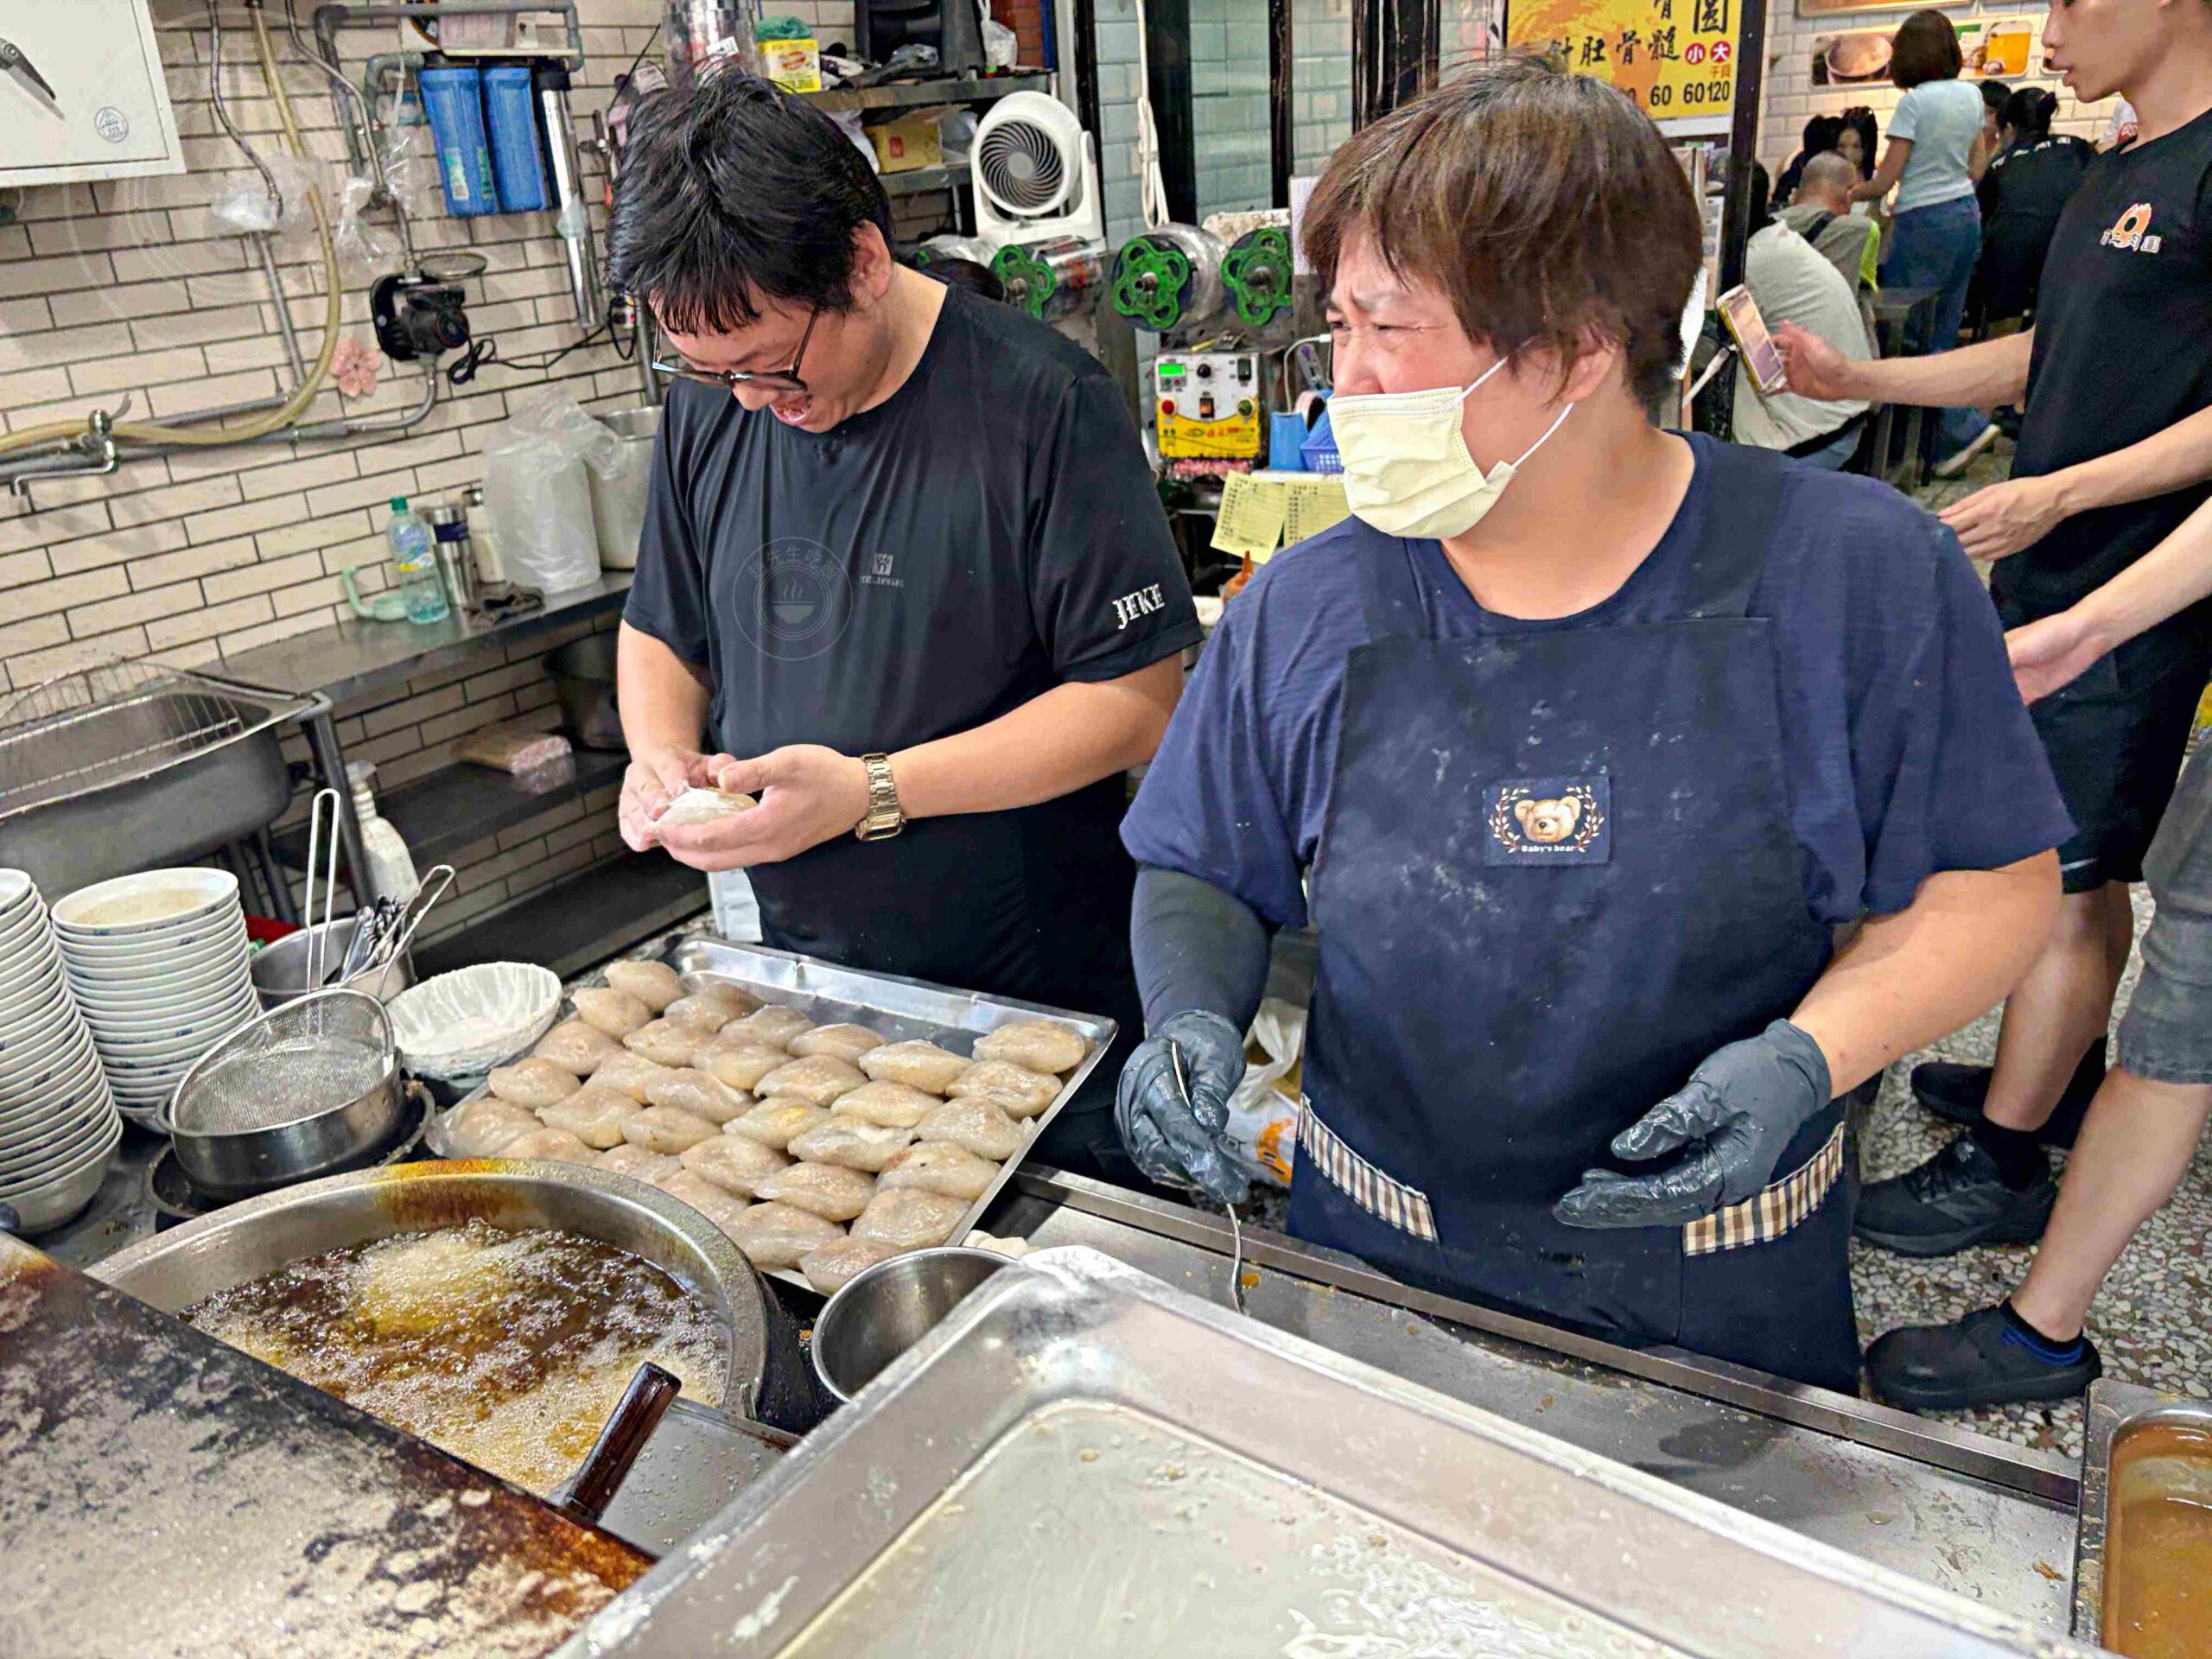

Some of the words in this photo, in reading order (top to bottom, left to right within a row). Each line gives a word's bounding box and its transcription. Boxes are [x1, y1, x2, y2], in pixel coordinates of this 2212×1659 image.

[1687, 45, 1705, 64] 小
[1711, 43, 1729, 61] 大
[1649, 85, 1672, 106] 60
[1683, 82, 1705, 105] 60
[1707, 79, 1731, 103] 120
[1112, 583, 1165, 630] JEKE
[1521, 845, 1553, 854] Baby's
